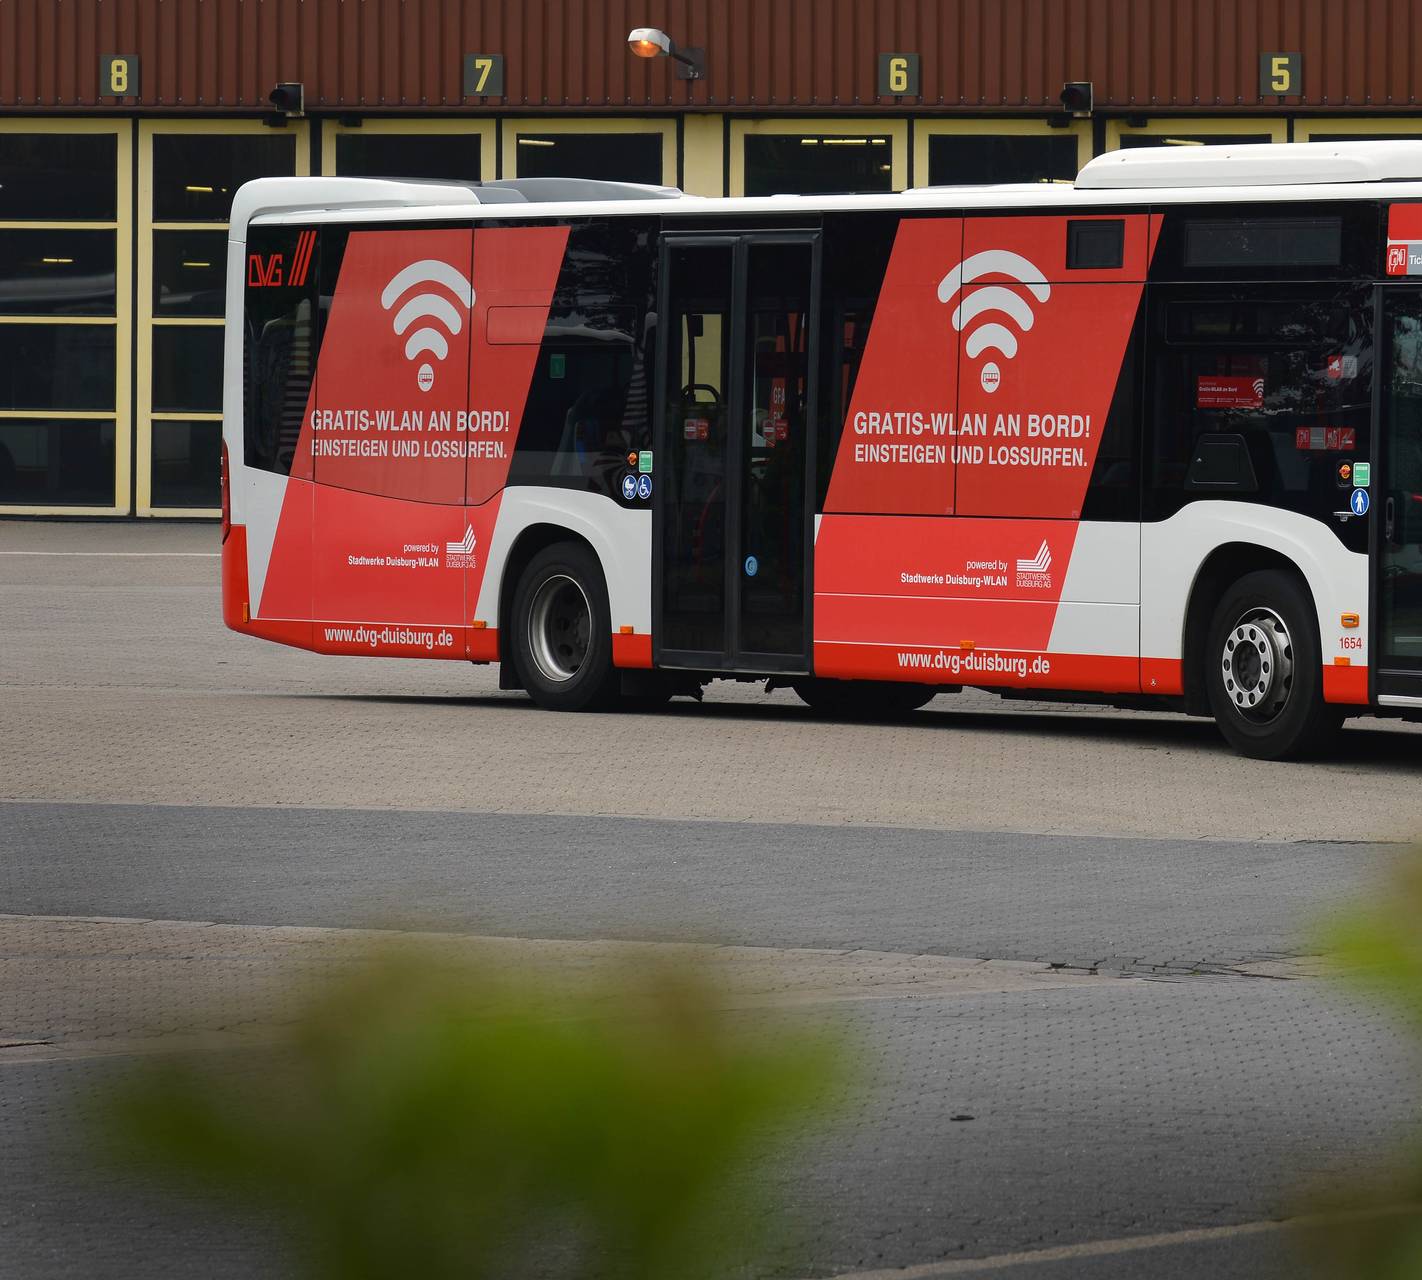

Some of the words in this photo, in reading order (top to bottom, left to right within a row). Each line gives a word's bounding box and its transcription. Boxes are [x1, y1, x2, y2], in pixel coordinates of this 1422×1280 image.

[110, 59, 128, 92] 8
[474, 59, 492, 92] 7
[889, 58, 907, 92] 6
[1271, 57, 1290, 91] 5
[248, 255, 282, 286] DVG
[310, 410, 423, 432] GRATIS-WLAN
[428, 411, 450, 431] AN
[456, 411, 510, 432] BORD!
[853, 412, 987, 436] GRATIS-WLAN
[993, 414, 1020, 436] AN
[1028, 415, 1090, 437] BORD!
[311, 439, 388, 457] EINSTEIGEN
[392, 440, 420, 457] UND
[424, 440, 507, 458] LOSSURFEN.
[855, 444, 945, 463] EINSTEIGEN
[951, 446, 984, 464] UND
[989, 447, 1087, 467] LOSSURFEN.
[403, 544, 430, 553] powered
[431, 544, 439, 554] by
[348, 555, 384, 566] Stadtwerke
[386, 556, 439, 568] Duisburg-WLAN
[966, 560, 997, 571] powered
[999, 560, 1008, 572] by
[901, 573, 944, 584] Stadtwerke
[945, 574, 1007, 588] Duisburg-WLAN
[1016, 572, 1051, 580] STADTWERKE
[1016, 580, 1042, 588] DUISBURG
[1043, 580, 1051, 588] AG
[325, 626, 453, 649] www.dvg-duisburg.de
[1339, 637, 1362, 649] 1654
[898, 651, 1050, 677] www.dvg-duisburg.de
